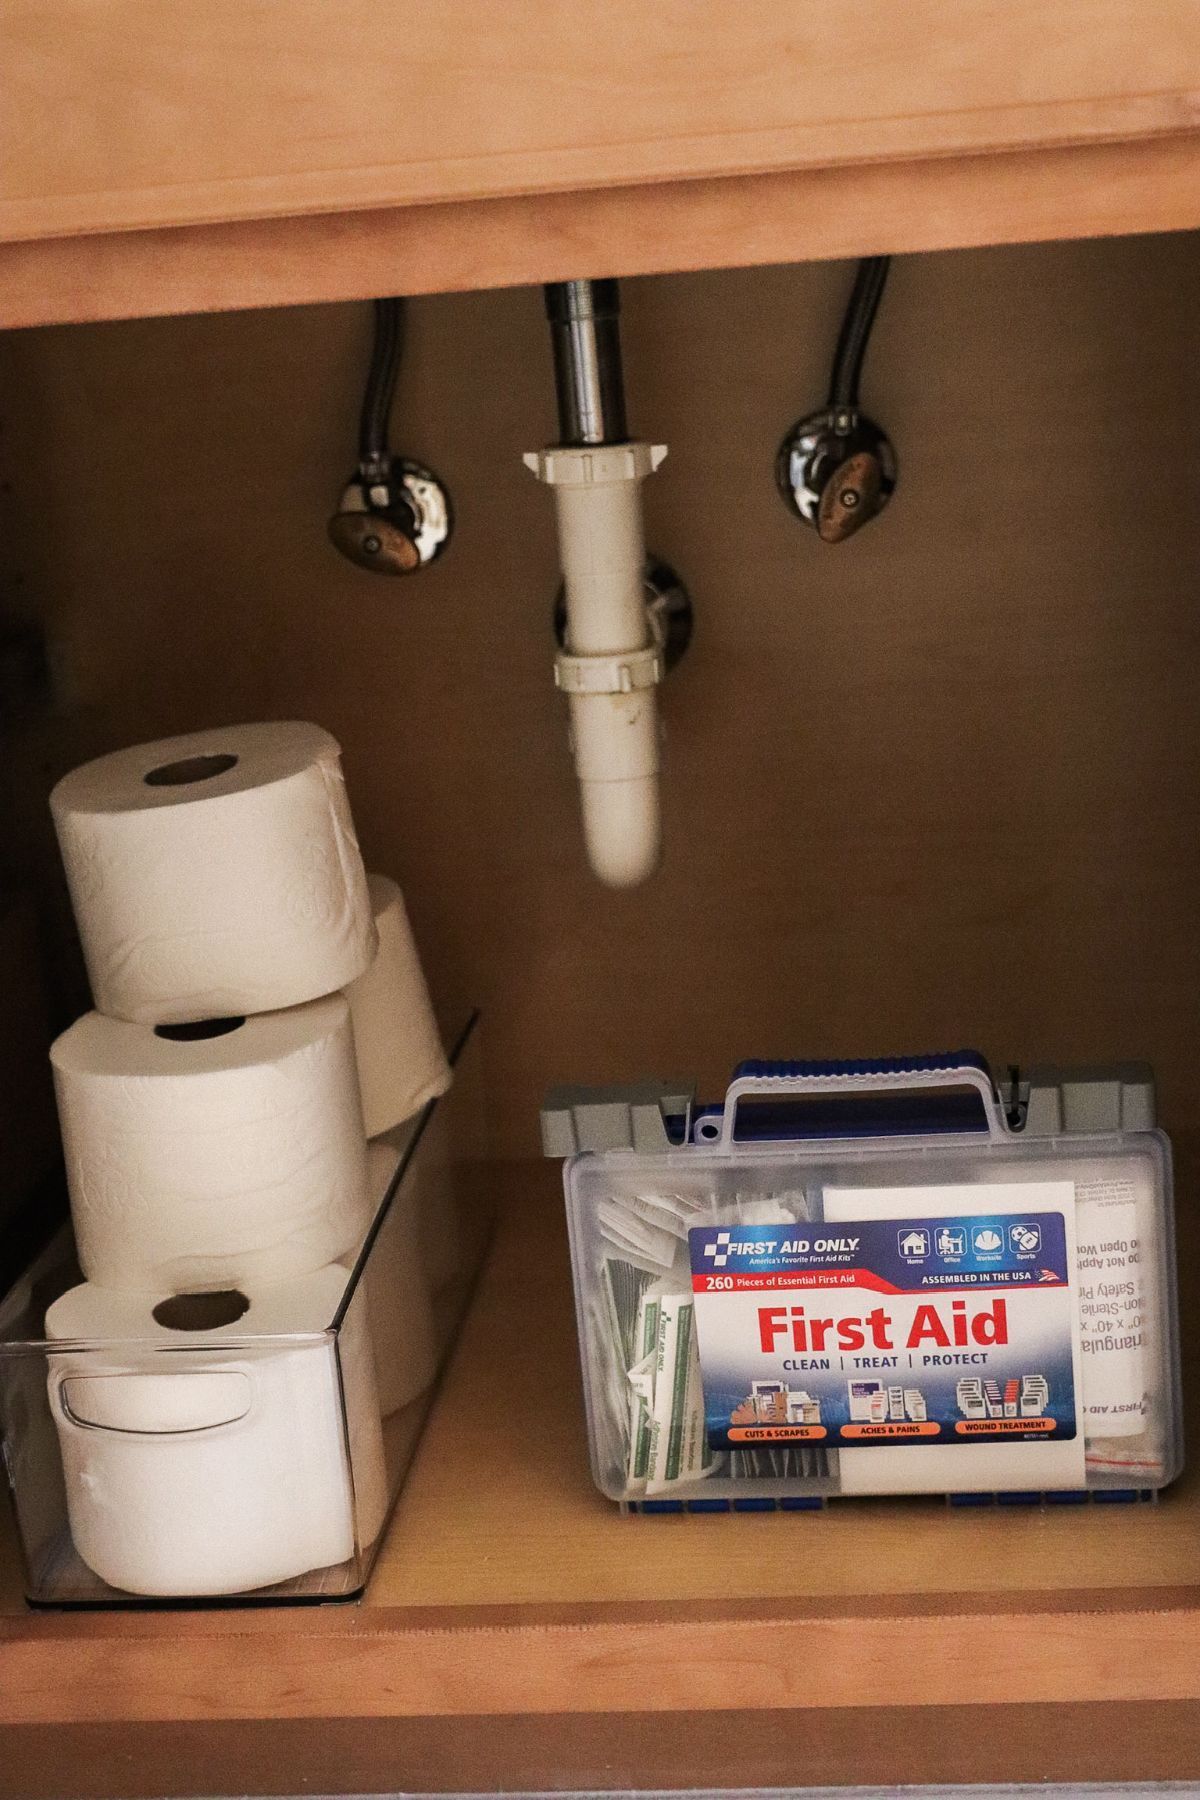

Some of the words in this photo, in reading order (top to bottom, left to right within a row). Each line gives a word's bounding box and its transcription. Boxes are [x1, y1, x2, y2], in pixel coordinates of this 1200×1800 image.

[727, 1241, 777, 1256] FIRST
[780, 1240, 810, 1254] AID
[1100, 1240, 1128, 1253] Open
[749, 1257, 781, 1265] America's
[782, 1256, 808, 1264] Favorite
[810, 1255, 824, 1263] First
[1106, 1257, 1126, 1268] Not
[706, 1276, 734, 1290] 260
[737, 1278, 764, 1287] Pieces
[766, 1277, 776, 1286] of
[778, 1276, 816, 1285] Essential
[818, 1275, 838, 1284] First
[840, 1274, 855, 1283] Aid
[922, 1274, 977, 1284] ASSEMBLED
[979, 1273, 991, 1282] IN
[993, 1273, 1010, 1281] THE
[1012, 1272, 1031, 1280] USA
[1097, 1282, 1135, 1298] Safety
[758, 1306, 894, 1353] First
[906, 1299, 1008, 1348] Aid
[1116, 1319, 1124, 1329] x
[783, 1358, 830, 1371] CLEAN
[853, 1356, 898, 1368] TREAT
[923, 1353, 988, 1366] PROTECT
[1089, 1406, 1108, 1414] AID
[1111, 1401, 1142, 1413] FIRST
[965, 1423, 997, 1431] WOUND
[999, 1421, 1046, 1429] TREATMENT
[745, 1429, 765, 1438] CUTS
[766, 1429, 772, 1437] &
[774, 1429, 810, 1437] SCRAPES
